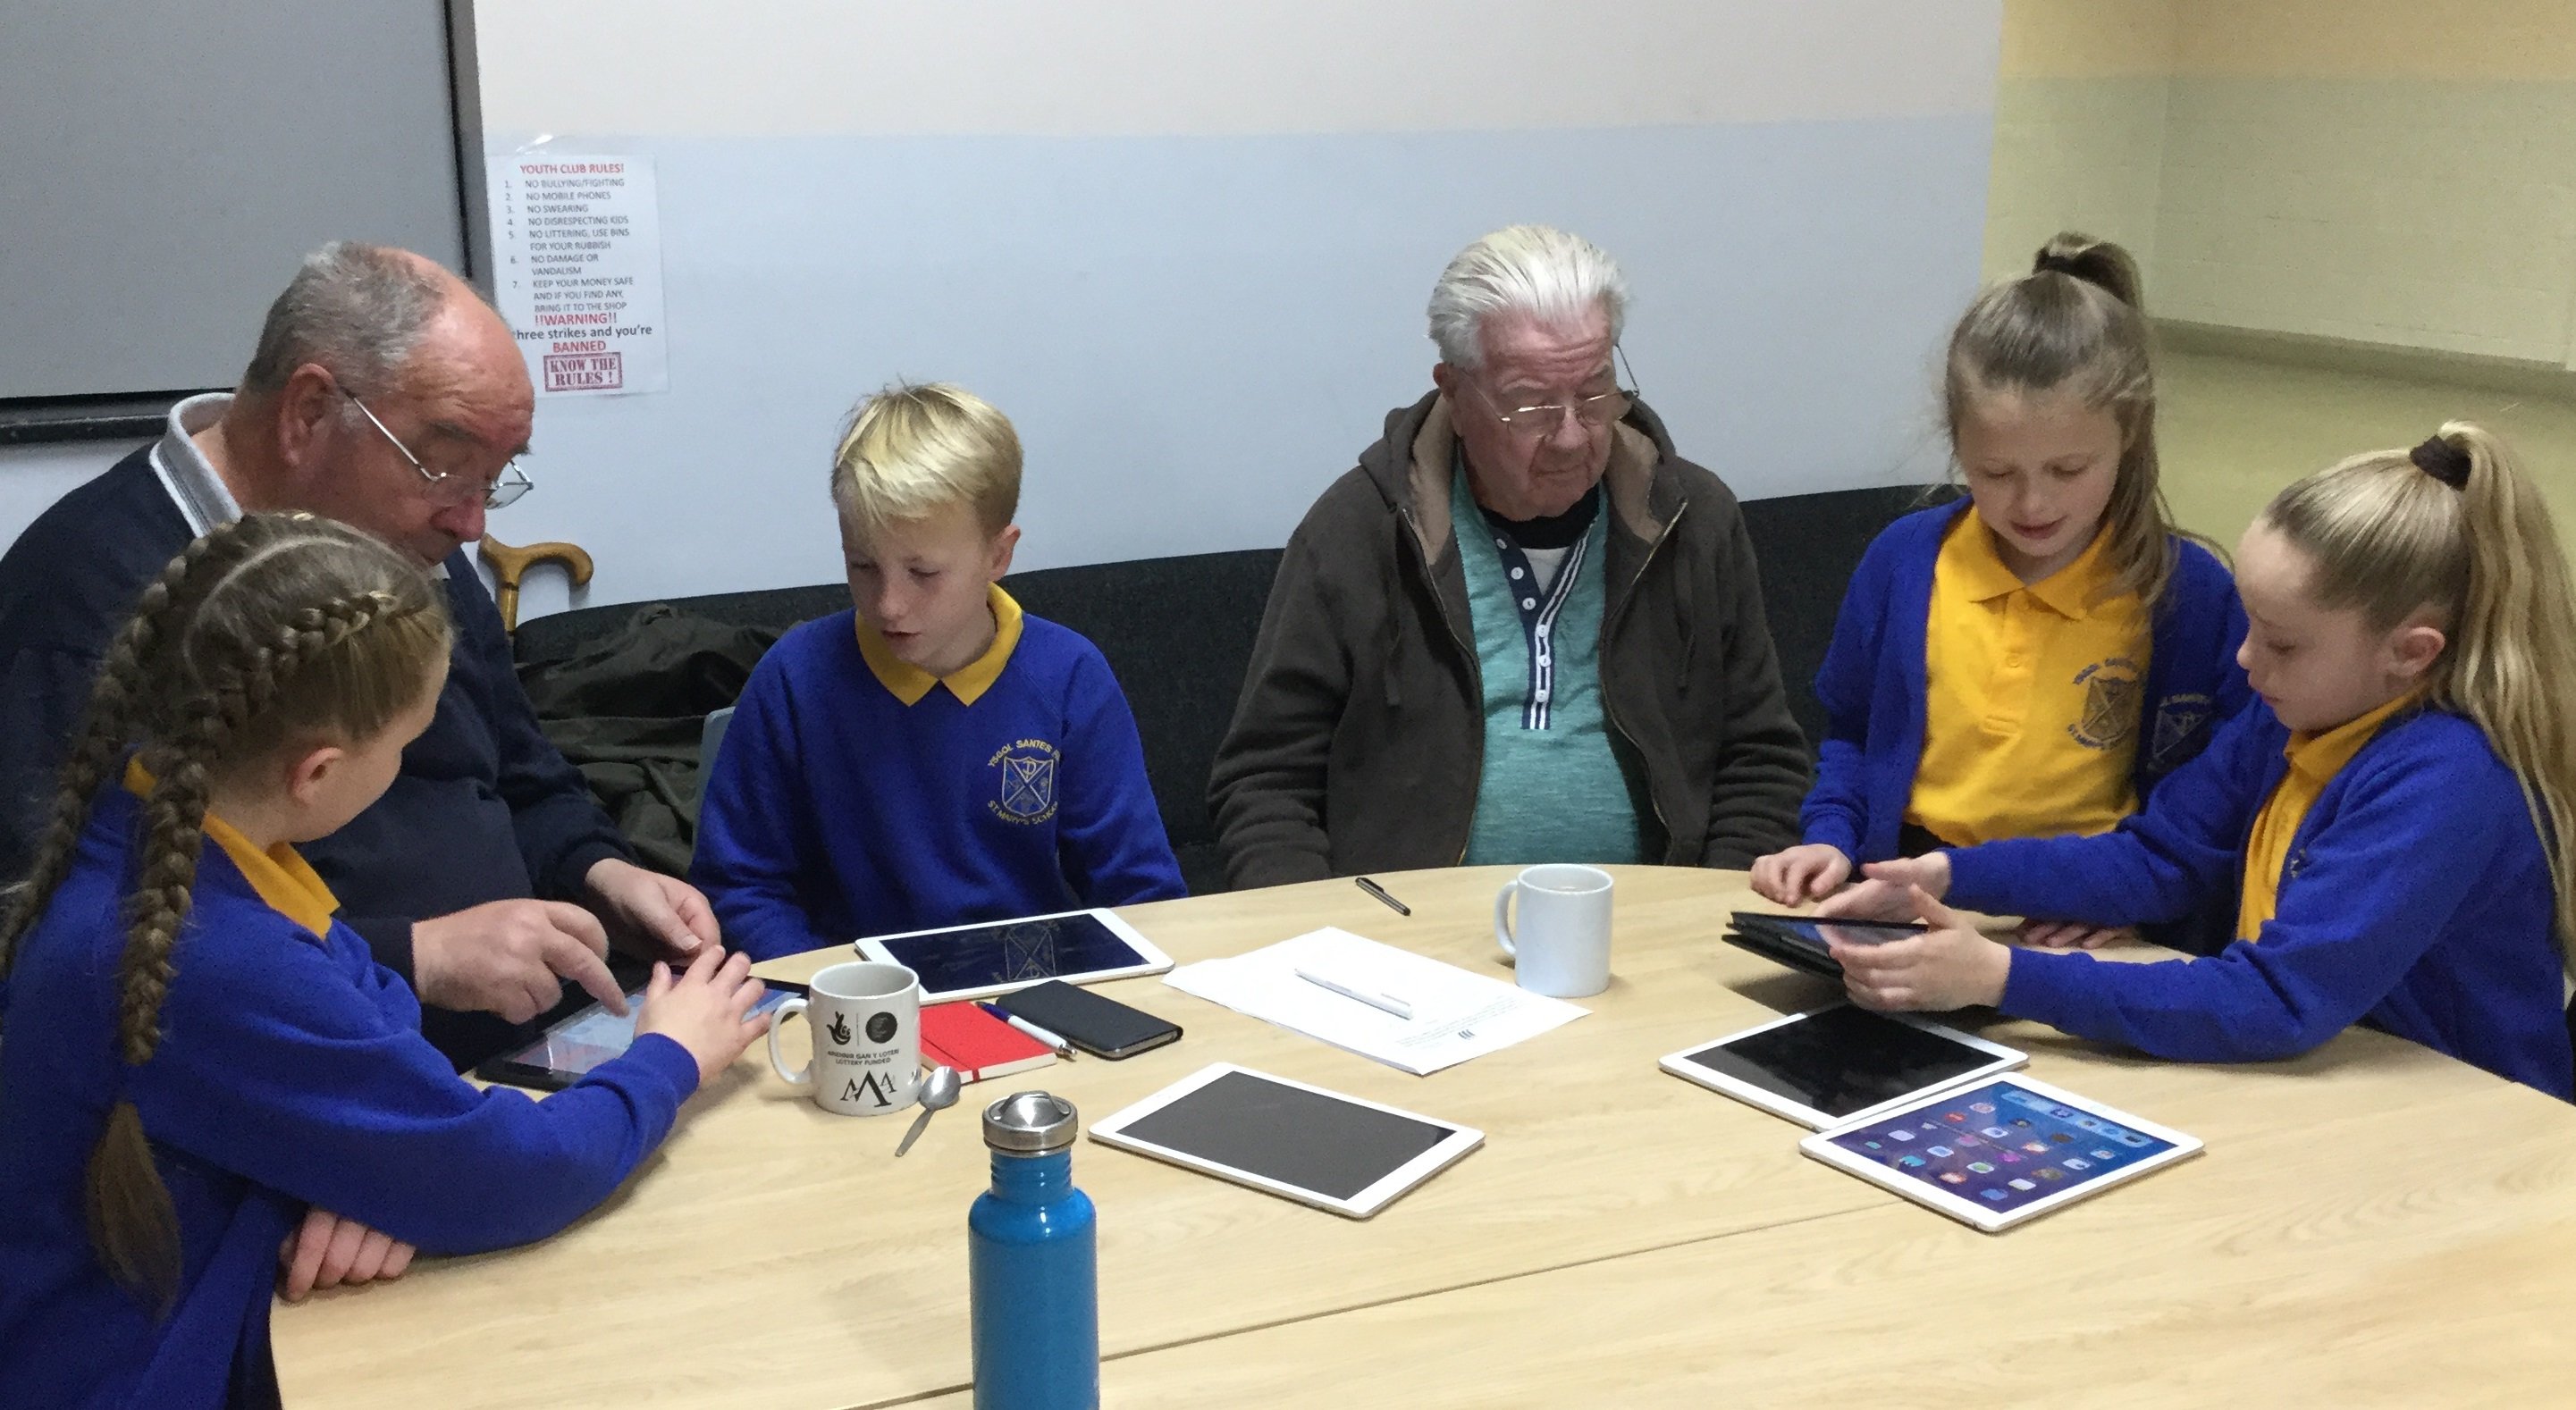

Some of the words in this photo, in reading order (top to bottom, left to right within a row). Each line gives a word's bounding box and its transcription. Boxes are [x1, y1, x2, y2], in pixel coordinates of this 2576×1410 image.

[519, 164, 558, 174] YOUTH
[560, 164, 586, 173] CLUB
[589, 163, 624, 173] RULES!
[525, 180, 539, 188] NO
[541, 178, 625, 188] BULLYING/FIGHTING
[526, 193, 541, 201] NO
[542, 191, 575, 200] MOBILE
[577, 190, 612, 200] PHONES
[527, 205, 542, 214] NO
[543, 204, 589, 213] SWEARING
[528, 218, 543, 226] NO
[543, 216, 608, 225] DISRESPECTING
[610, 215, 629, 224] KIDS
[529, 230, 543, 239] NO
[592, 229, 609, 238] USE
[610, 228, 630, 237] BINS
[530, 242, 548, 251] FOR
[549, 241, 574, 250] YOUR
[575, 240, 611, 250] RUBBISH
[531, 256, 545, 264] NO
[547, 254, 584, 263] DAMAGE
[586, 254, 599, 262] OR
[532, 267, 582, 275] VANDALISM
[533, 280, 553, 288] KEEP
[556, 279, 578, 288] YOUR
[581, 278, 612, 287] MONEY
[614, 277, 634, 286] SAFE
[534, 292, 552, 300] AND
[554, 291, 562, 300] IF
[564, 291, 582, 299] YOU
[584, 290, 603, 298] FIND
[535, 304, 561, 312] BRING
[563, 303, 571, 312] IT
[573, 303, 585, 311] TO
[586, 302, 602, 311] THE
[604, 301, 627, 310] SHOP
[535, 312, 617, 326] !!WARNING!!
[548, 328, 586, 339] strikes
[590, 325, 612, 337] and
[615, 324, 652, 338] you're
[553, 340, 606, 353] BANNED
[550, 358, 586, 373] KNOW
[590, 357, 617, 371] THE
[555, 372, 603, 386] RULES
[1015, 739, 1052, 753] SANTES
